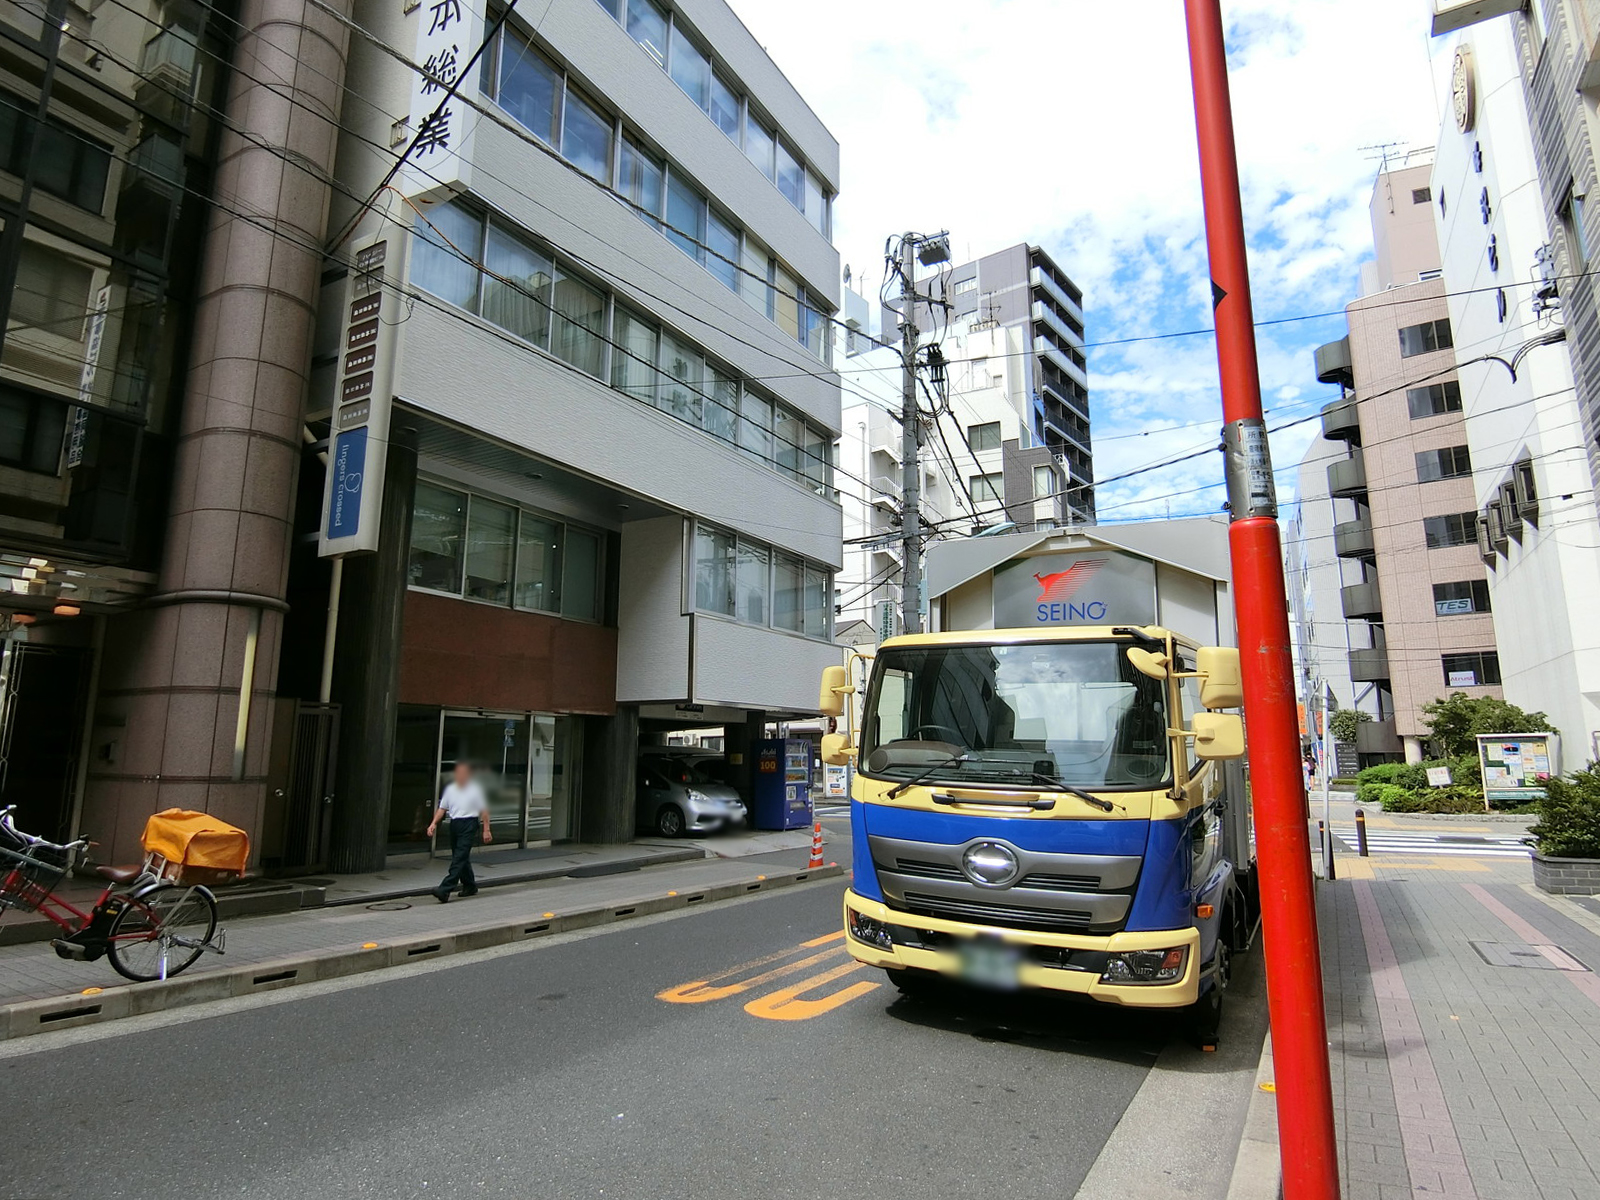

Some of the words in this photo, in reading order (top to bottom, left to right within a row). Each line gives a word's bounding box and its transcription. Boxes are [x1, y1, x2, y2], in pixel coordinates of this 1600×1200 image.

[334, 484, 344, 527] crossed
[1036, 601, 1108, 622] SEINO
[1436, 599, 1469, 611] TES
[760, 760, 776, 770] 100
